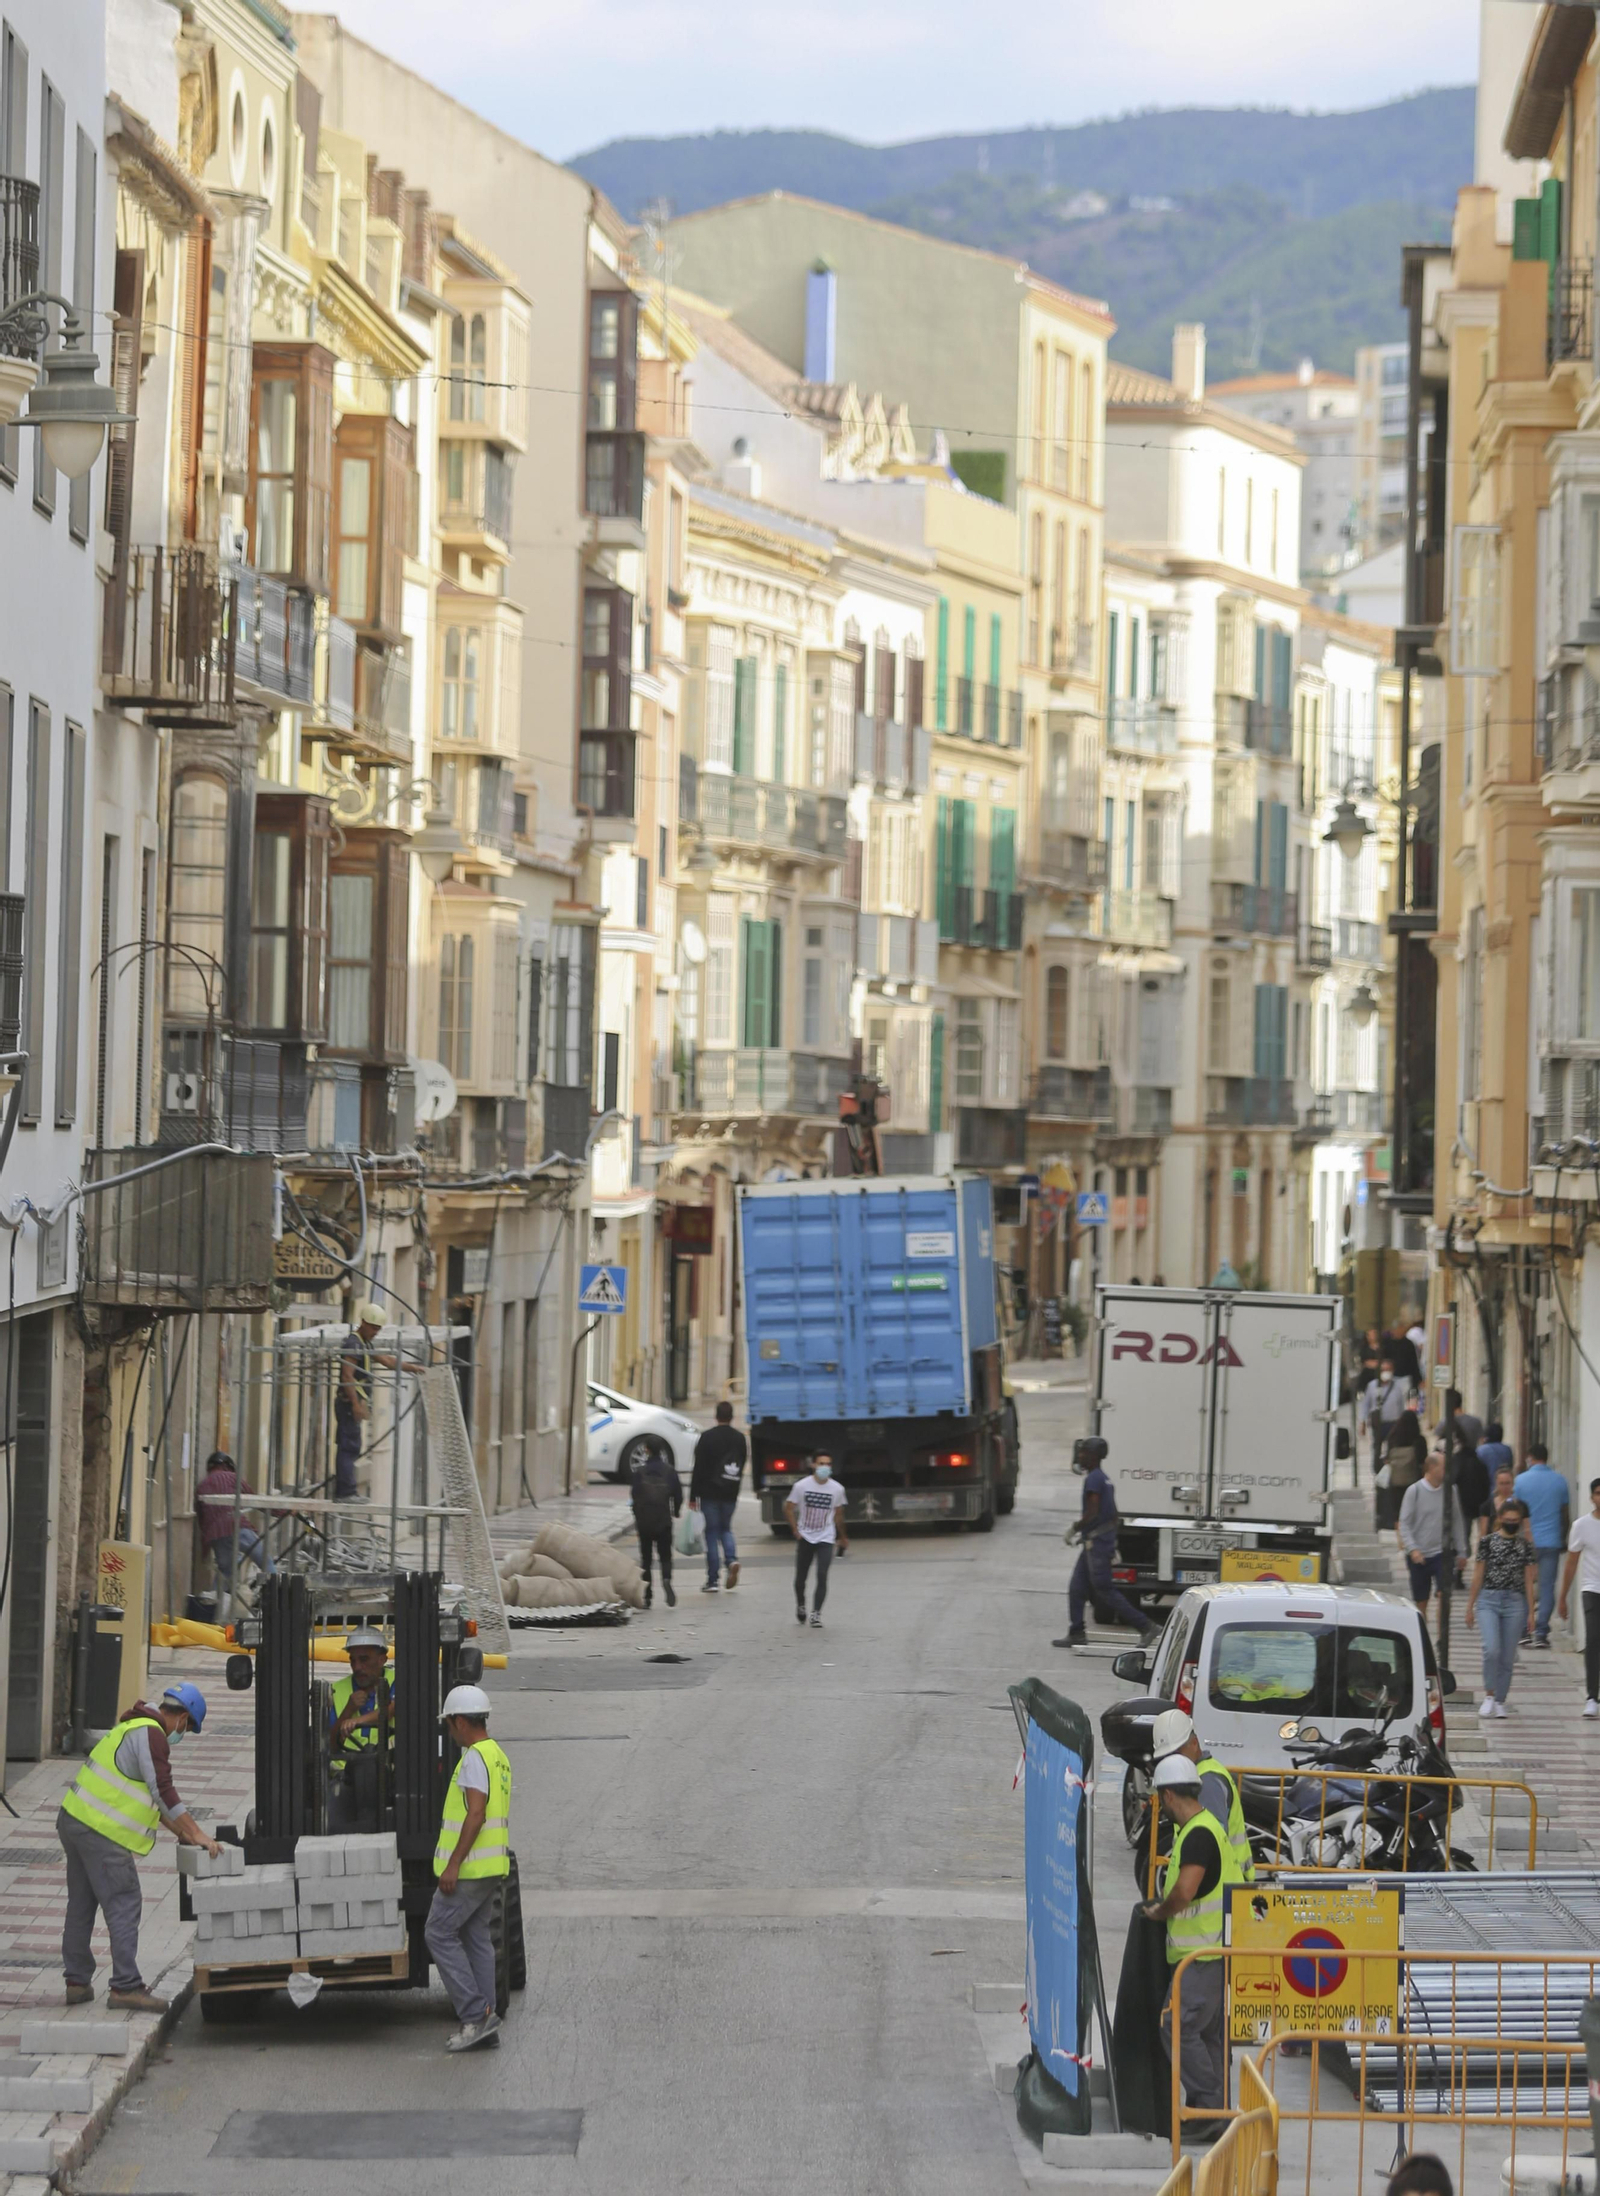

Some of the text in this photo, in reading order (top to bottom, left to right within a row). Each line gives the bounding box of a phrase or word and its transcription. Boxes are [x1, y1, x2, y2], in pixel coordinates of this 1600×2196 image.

[275, 1241, 338, 1258] Estrea
[277, 1258, 334, 1275] Galicia
[1111, 1331, 1245, 1367] RDA
[1236, 1561, 1273, 1570] MALAGA
[1262, 1554, 1291, 1563] LOCAL
[1272, 1893, 1378, 1909] POLICIA LOCAL
[1293, 1910, 1356, 1924] MALAGA
[1234, 2003, 1290, 2019] PROHIBDO
[1293, 2004, 1356, 2019] ESTACIONAR
[1233, 2022, 1254, 2038] LAS
[1259, 2021, 1270, 2038] 7
[1377, 2016, 1388, 2036] 8
